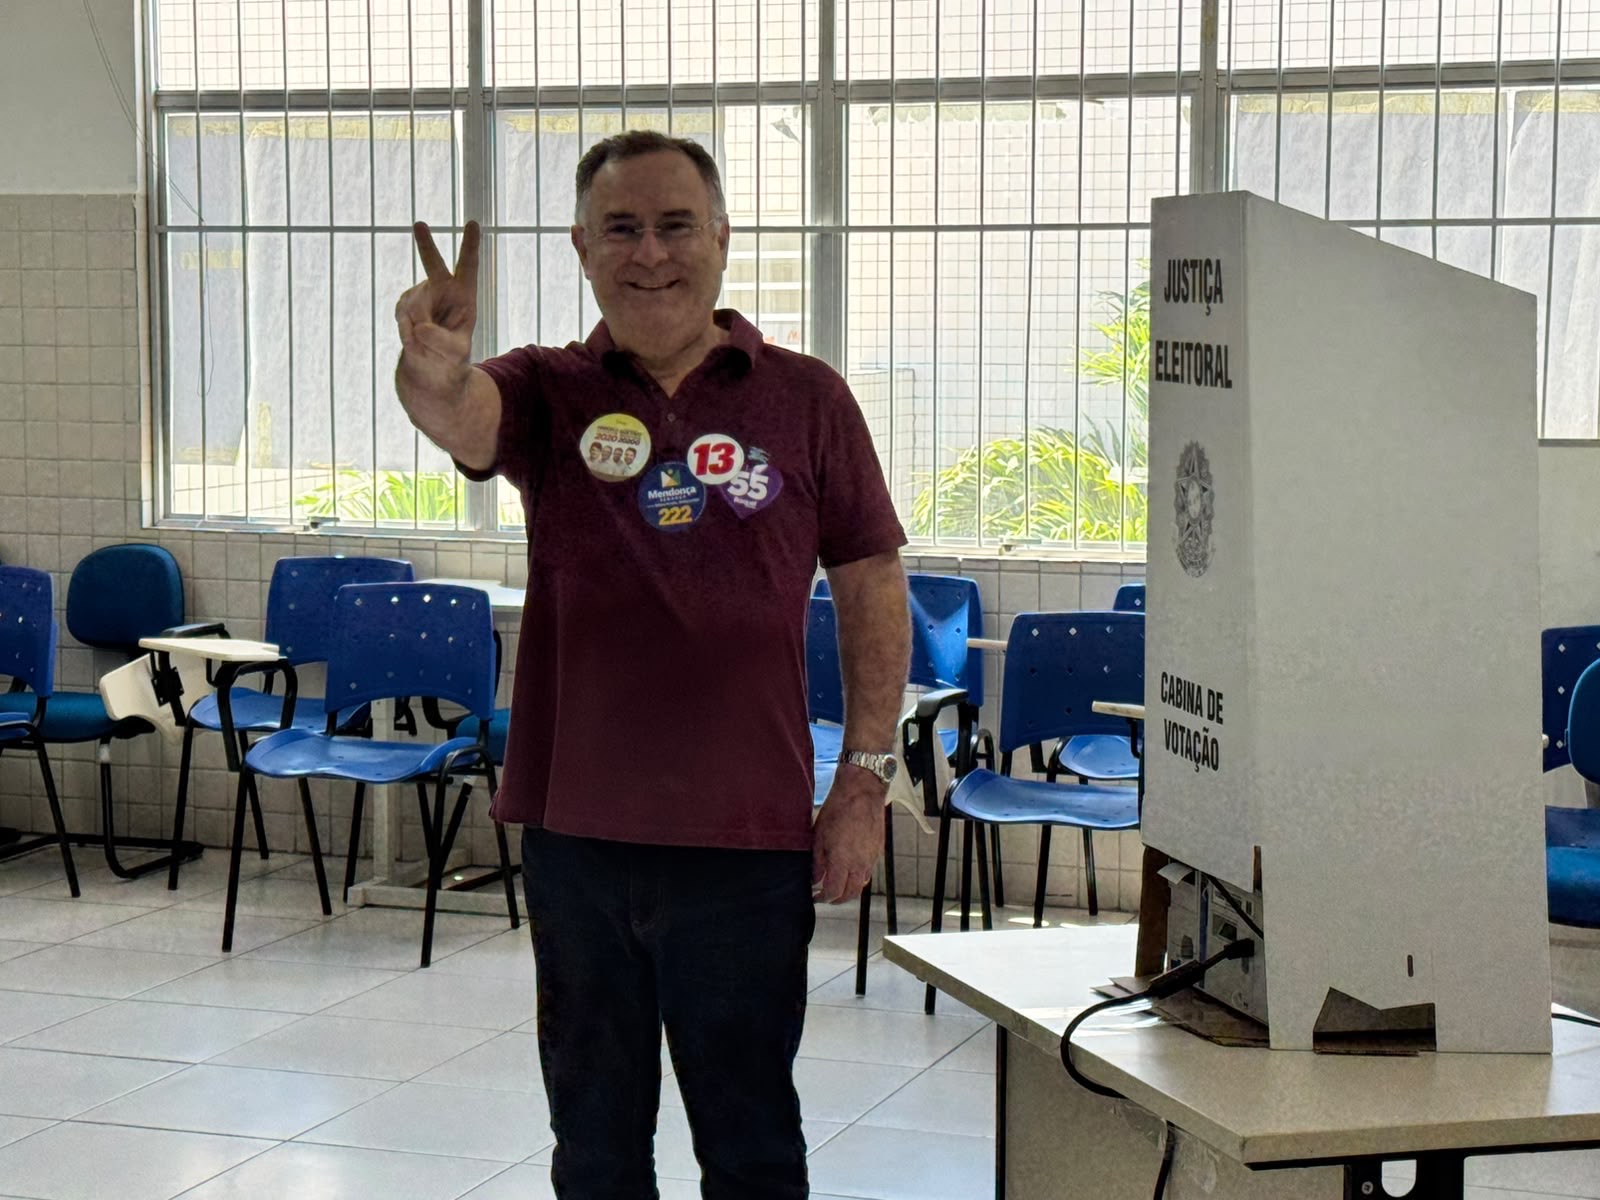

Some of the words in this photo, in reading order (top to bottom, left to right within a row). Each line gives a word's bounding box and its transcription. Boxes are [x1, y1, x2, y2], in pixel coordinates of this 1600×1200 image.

[1164, 258, 1223, 316] JUSTIÇA
[1155, 340, 1232, 389] ELEITORAL
[694, 443, 736, 476] 13
[647, 486, 697, 500] Mendonça
[727, 464, 769, 501] 55
[658, 504, 693, 526] 222
[1161, 671, 1203, 718] CABINA
[1207, 688, 1224, 725] DE
[1163, 718, 1219, 773] VOTAÇÃO
